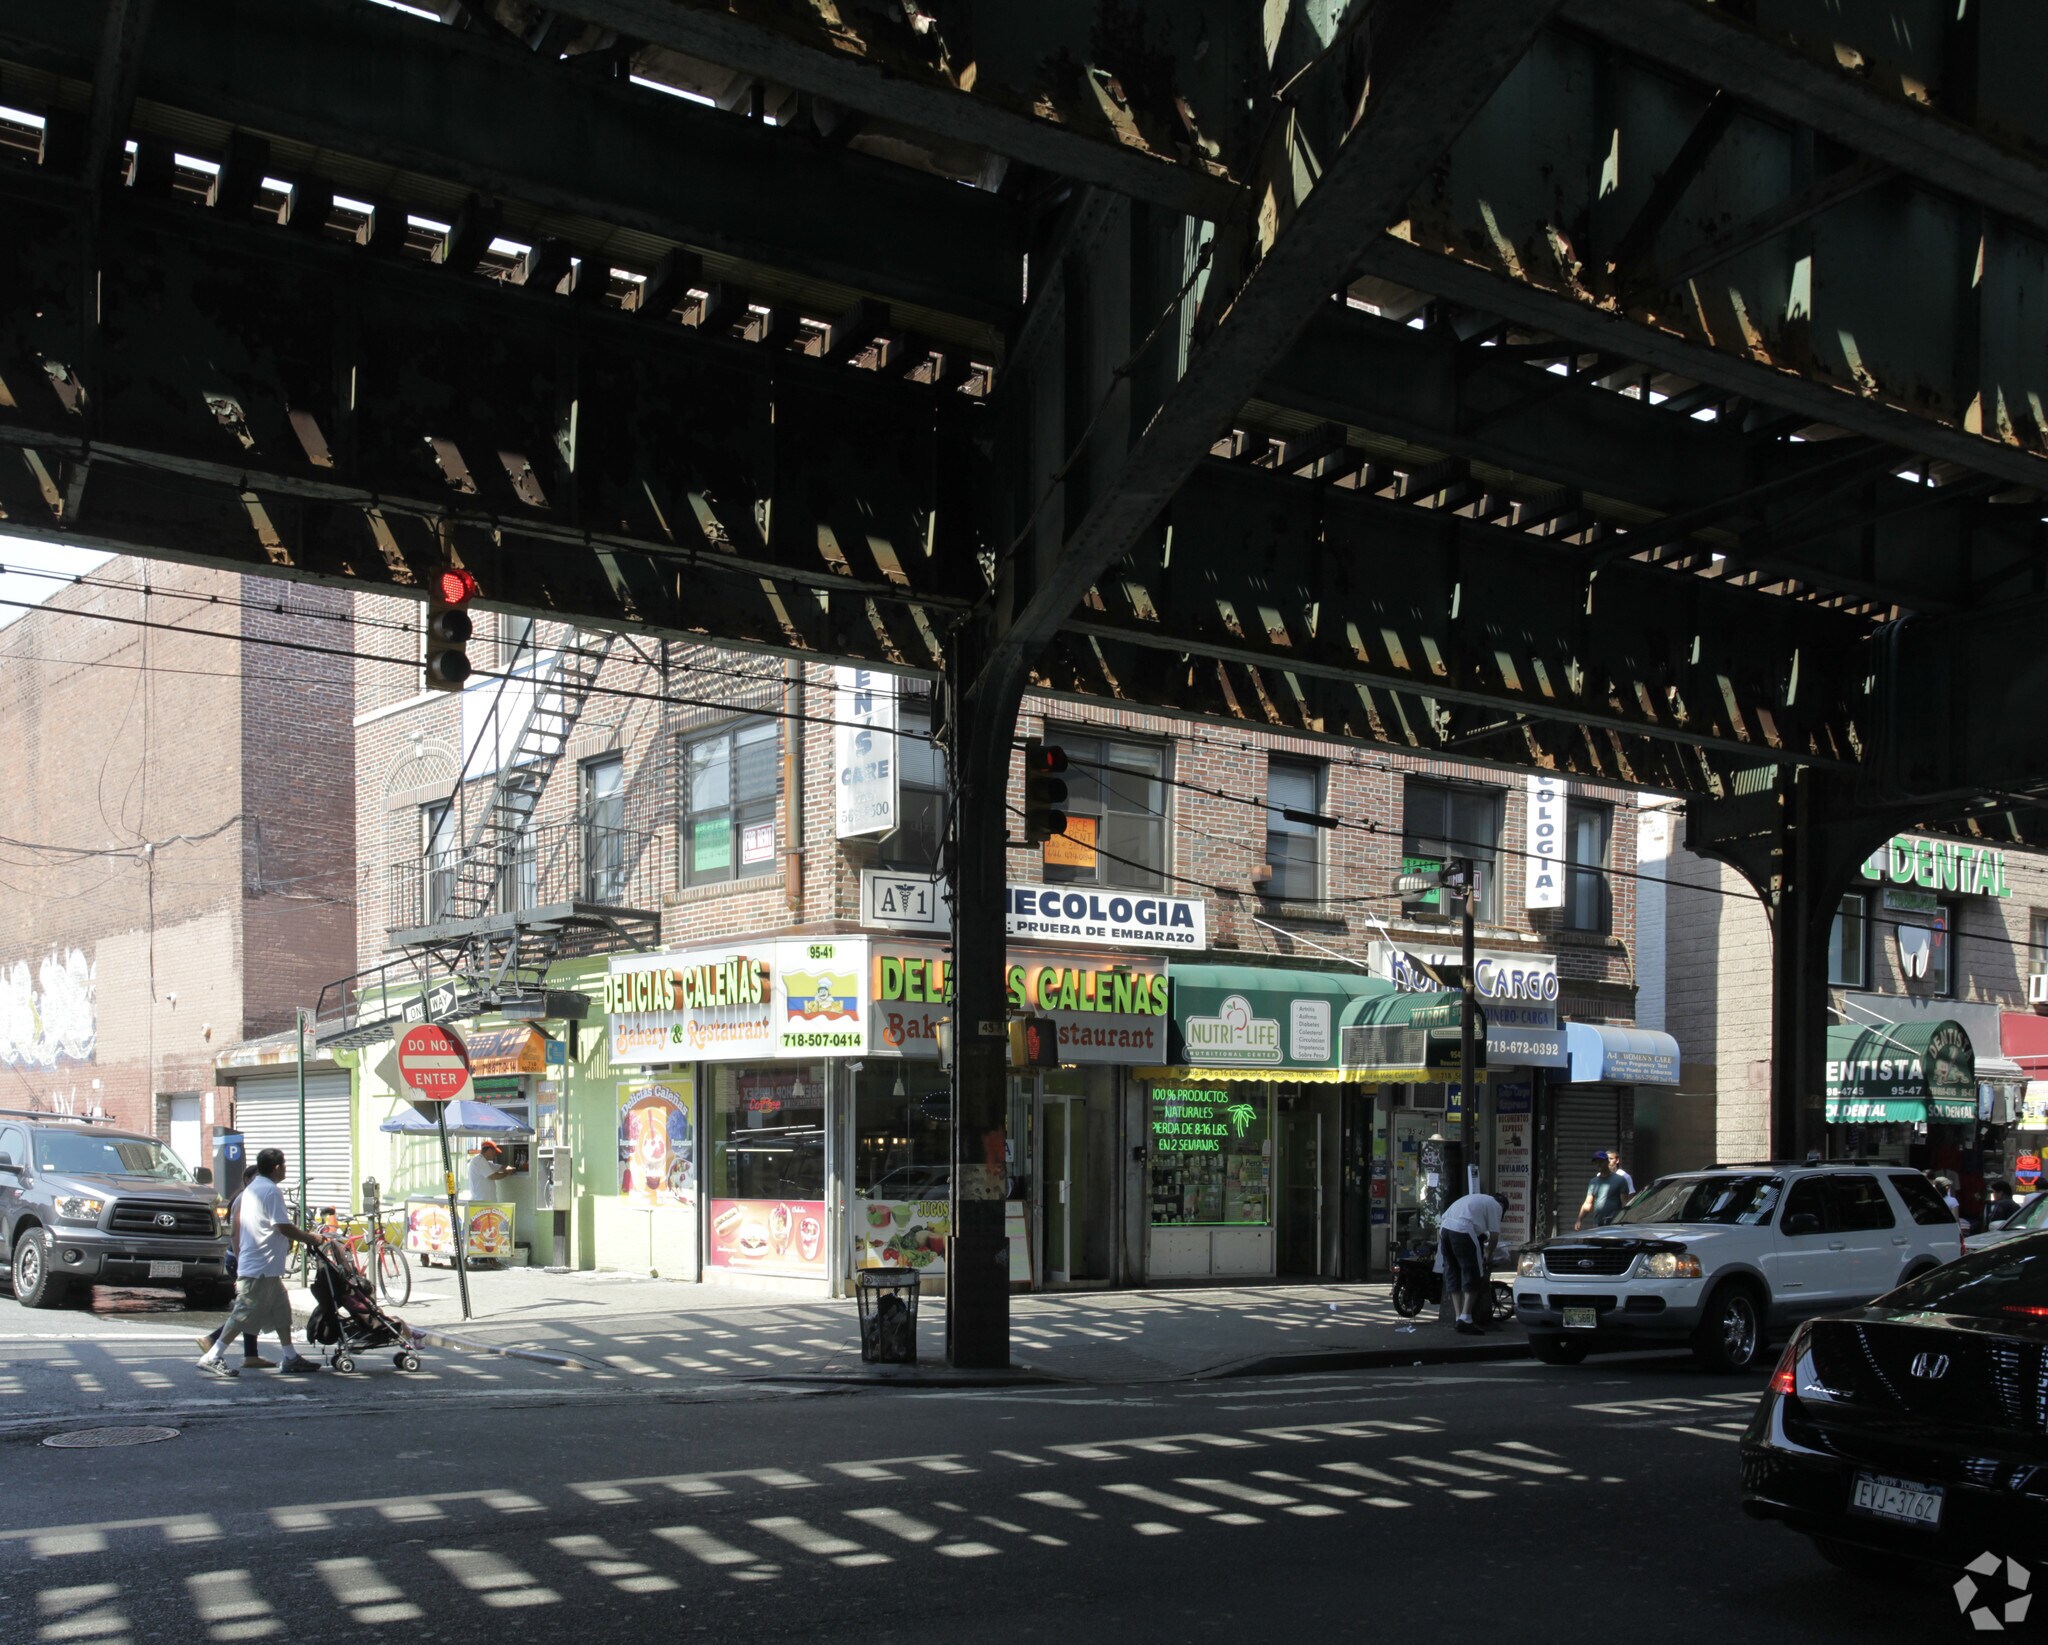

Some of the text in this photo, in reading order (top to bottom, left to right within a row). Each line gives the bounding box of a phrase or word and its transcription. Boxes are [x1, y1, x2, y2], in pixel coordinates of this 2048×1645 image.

[841, 760, 889, 786] CARE
[1536, 776, 1554, 889] COLOGIA
[1889, 836, 2013, 898] DENTAL
[881, 886, 896, 913] A
[1017, 921, 1195, 943] PRUEBA DE EMBARAZO
[603, 955, 763, 1014] DELICIAS CALEÑAS
[1475, 959, 1559, 1001] CARGO
[1037, 965, 1169, 1016] CALEÑAS
[411, 994, 448, 1019] ON WAY
[1412, 1008, 1450, 1027] WARREN
[1521, 1013, 1549, 1026] CARGA
[617, 1015, 770, 1055] Bakery & Restaurant
[883, 1012, 1155, 1048] Bak staurant
[408, 1040, 425, 1051] DO
[430, 1039, 455, 1051] NOT
[1487, 1039, 1559, 1056] 718-672-0392
[1929, 1028, 1974, 1061] DENTISTA
[1190, 1050, 1243, 1058] NUTRITIONAL
[1623, 1053, 1652, 1062] WOMEN'S
[1654, 1055, 1672, 1064] CARE
[1629, 1060, 1655, 1068] Pregnancy
[1826, 1058, 1925, 1083] ENTISTA
[415, 1073, 457, 1085] ENTER
[621, 1085, 689, 1115] Delicias Caleñas
[1177, 1089, 1229, 1103] PRODUCTOS
[1826, 1086, 1923, 1097] 98-4745 95-47
[1165, 1106, 1214, 1119] NATURALES
[1498, 1114, 1530, 1124] DOCUMENTOS
[1826, 1103, 1887, 1118] OL DENTAL
[1928, 1103, 1976, 1119] SOL DENTAL
[1152, 1122, 1180, 1135] PIERDA
[1181, 1122, 1193, 1135] DE
[1194, 1123, 1211, 1136] 8-16
[1502, 1124, 1523, 1133] EXPRESS
[229, 1146, 239, 1159] P
[1159, 1138, 1220, 1152] EN 2 SEMANAS
[1498, 1164, 1530, 1174] ENVIAMOS
[917, 1201, 949, 1218] JUGOS
[1877, 1475, 1923, 1492] NEW YORK
